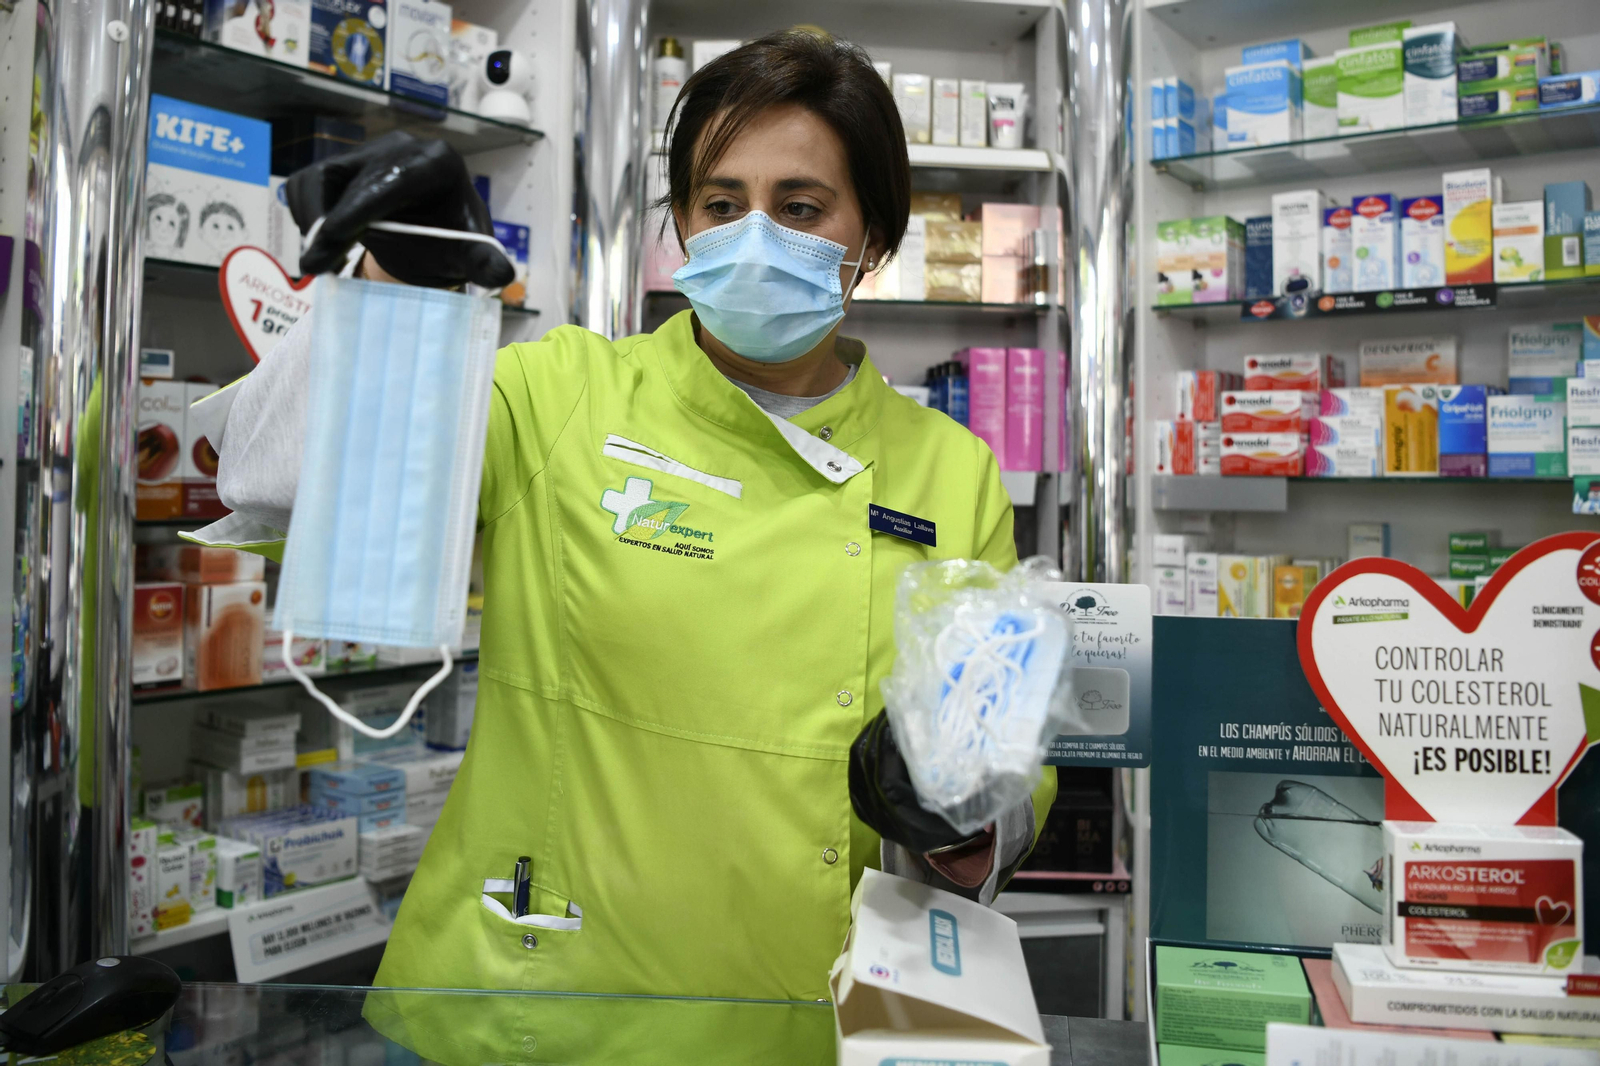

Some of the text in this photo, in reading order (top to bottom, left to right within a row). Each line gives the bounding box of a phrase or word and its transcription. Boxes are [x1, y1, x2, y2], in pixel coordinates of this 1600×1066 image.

[1338, 51, 1396, 70] cinfatós
[1229, 68, 1284, 88] cinfatós
[156, 112, 245, 154] KIFE+
[1511, 332, 1570, 347] Friolgrip
[1491, 407, 1553, 421] Friolgrip
[882, 513, 911, 527] Angustias
[893, 525, 913, 535] Auxiliar
[619, 537, 651, 549] EXPERTOS
[661, 545, 683, 556] SALUD
[684, 551, 714, 560] NATURAL
[674, 542, 714, 554] AQUÍ SOMOS
[1348, 596, 1410, 610] Arkopharma
[1532, 604, 1584, 615] CLÍNICAMENTE
[1097, 631, 1141, 648] favorito
[1084, 646, 1126, 664] quieras!
[1375, 645, 1504, 672] CONTROLAR
[1374, 679, 1552, 707] TU COLESTEROL
[1219, 722, 1239, 738] LOS
[1242, 721, 1292, 741] CHAMPÚS
[1295, 722, 1338, 743] SÓLIDOS
[1379, 712, 1548, 741] NATURALMENTE
[1198, 745, 1208, 757] EN
[1210, 746, 1218, 758] EL
[1220, 746, 1244, 759] MEDIO
[1246, 747, 1282, 760] AMBIENTE
[1285, 749, 1290, 760] Y
[1292, 745, 1340, 763] AHORRAN
[1343, 747, 1355, 763] EL
[1414, 747, 1551, 775] ¡ES POSIBLE!
[1424, 843, 1481, 854] Arkopharma
[1408, 905, 1469, 918] COLESTEROL
[1387, 1001, 1478, 1016] COMPROMETIDOS
[1480, 1006, 1501, 1018] CON
[1503, 1007, 1518, 1019] LA
[1520, 1008, 1555, 1021] SALUD
